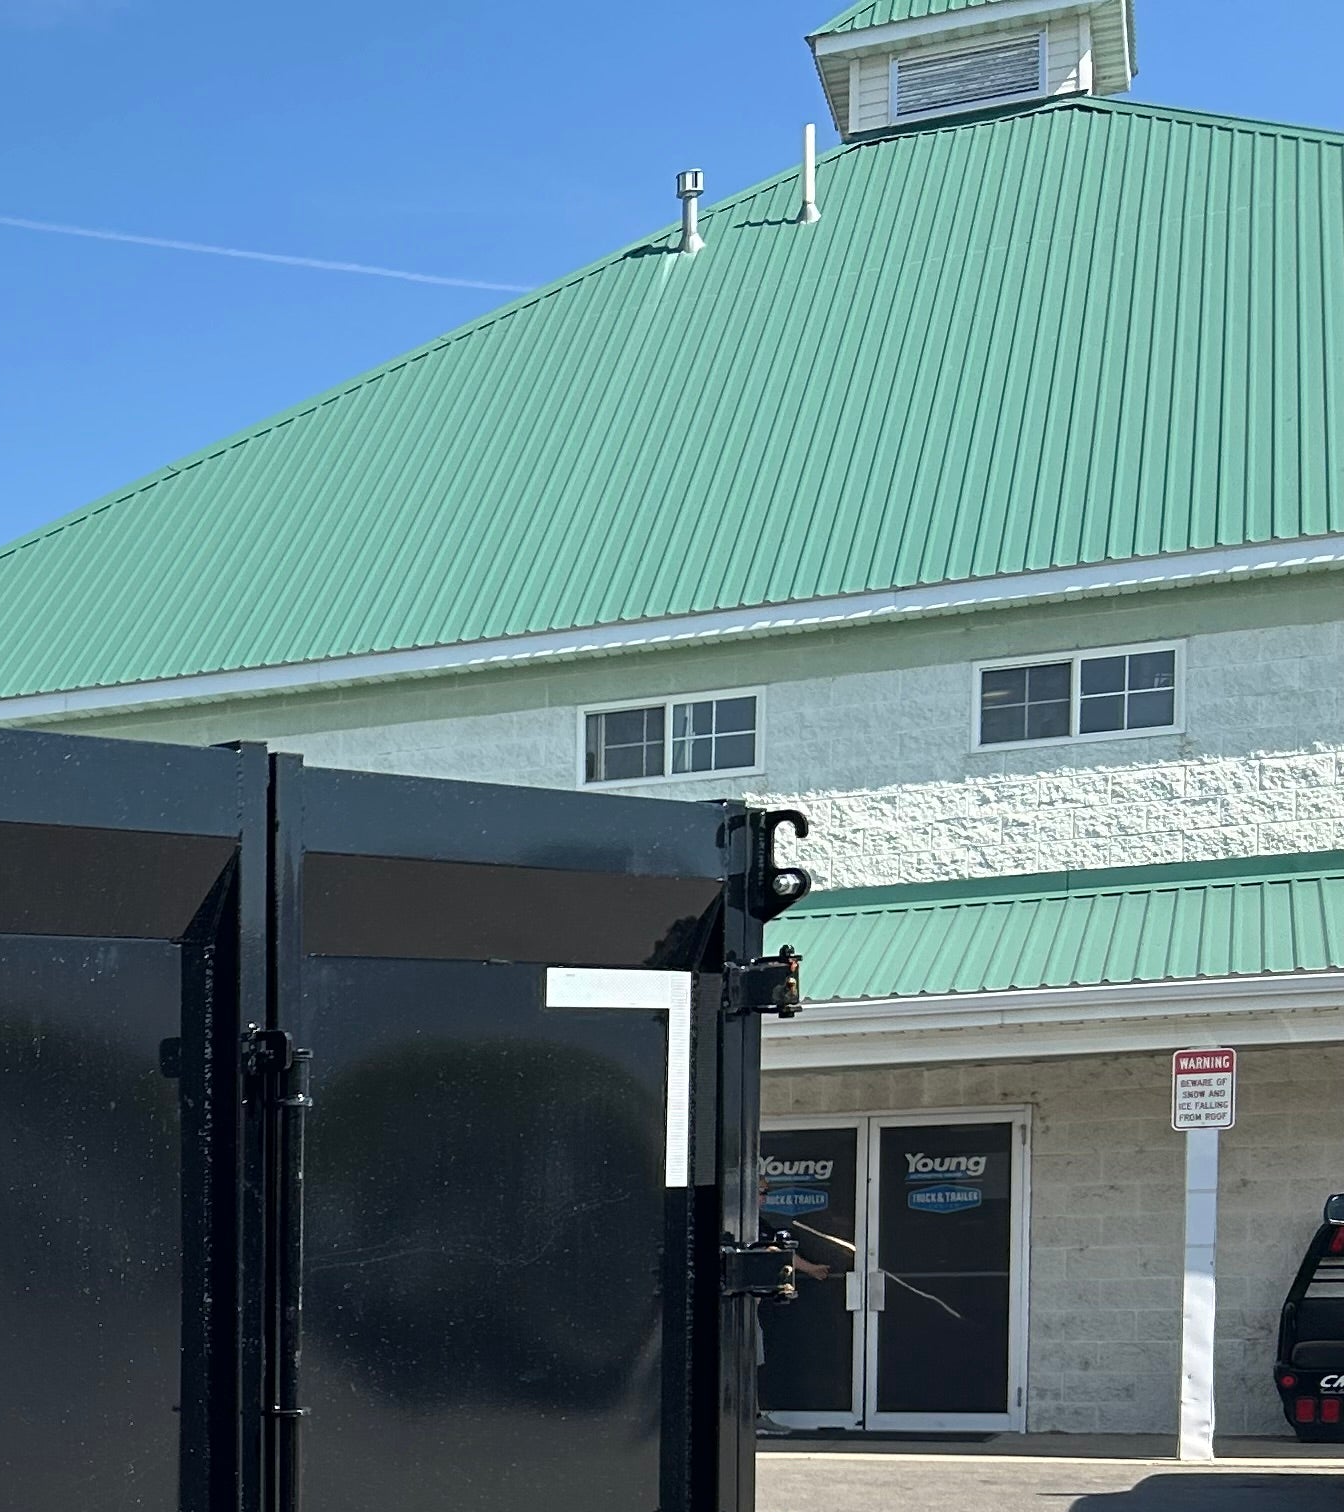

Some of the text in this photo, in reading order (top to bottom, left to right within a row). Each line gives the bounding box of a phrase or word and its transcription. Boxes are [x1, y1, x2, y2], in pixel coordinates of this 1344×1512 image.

[1179, 1056, 1230, 1070] WARNING
[1181, 1078, 1227, 1087] BEWARE OF
[1208, 1090, 1225, 1098] AND
[1178, 1101, 1229, 1110] ICE FALLING
[1179, 1114, 1201, 1122] FROM
[759, 1156, 833, 1179] Young
[905, 1153, 987, 1176] Young
[912, 1192, 978, 1203] TRUCK & TRAILER
